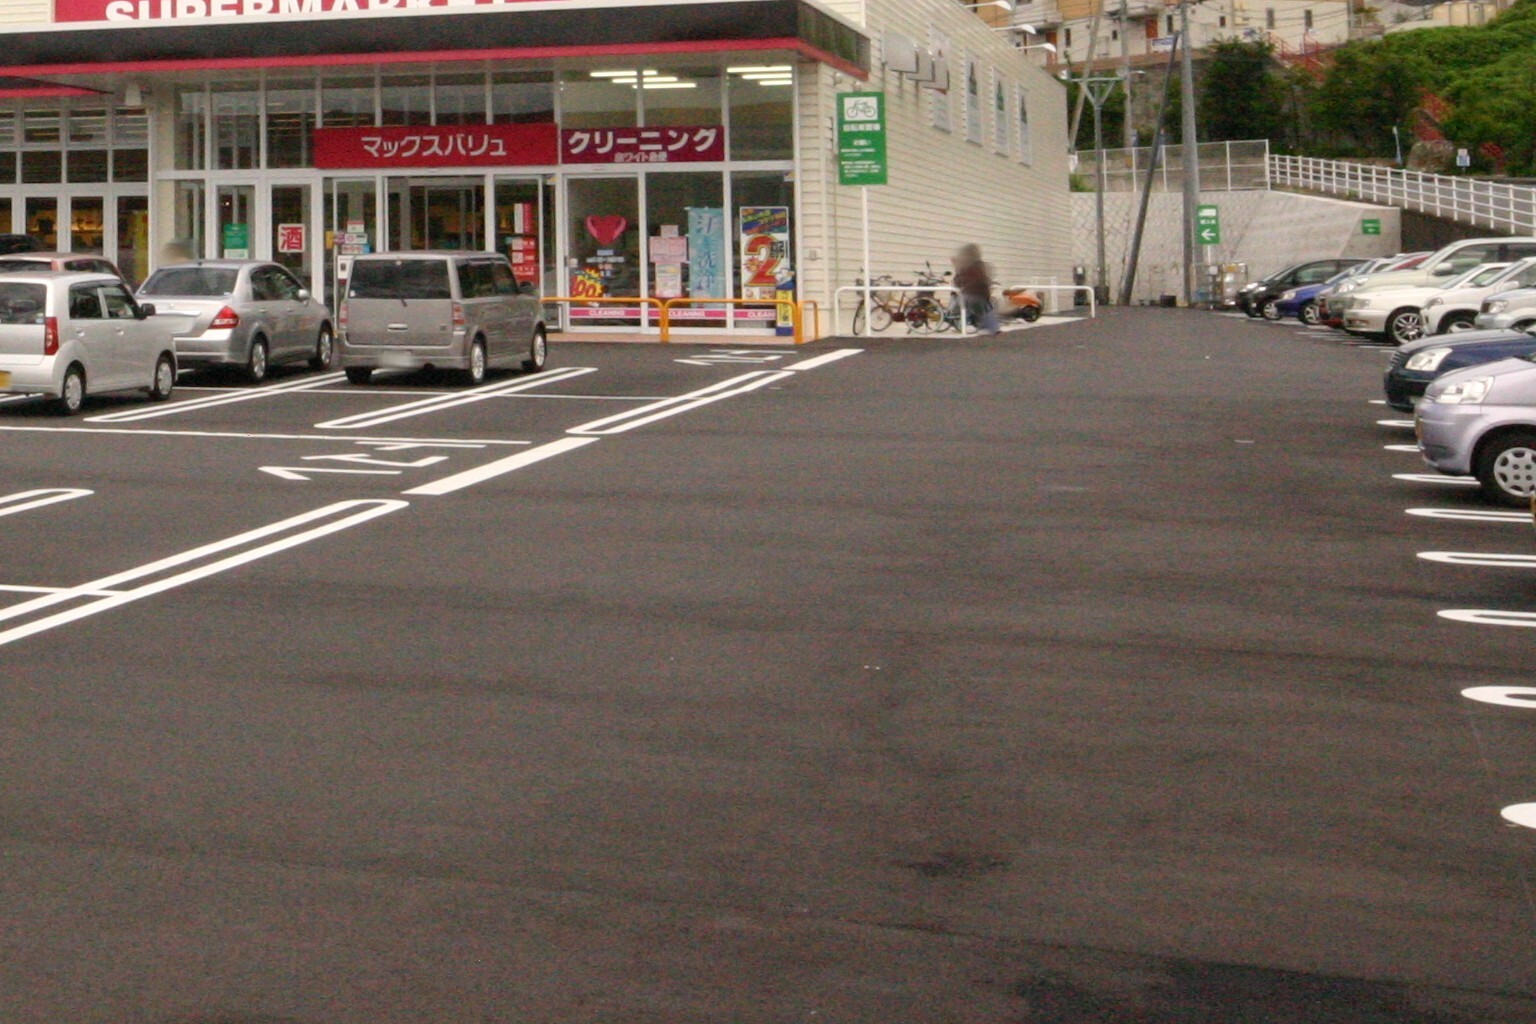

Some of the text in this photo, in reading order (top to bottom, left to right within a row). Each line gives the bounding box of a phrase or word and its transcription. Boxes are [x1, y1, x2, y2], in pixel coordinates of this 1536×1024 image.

[361, 133, 508, 158] マックスバリュ
[568, 128, 716, 155] クリーニング
[280, 226, 302, 250] 酒
